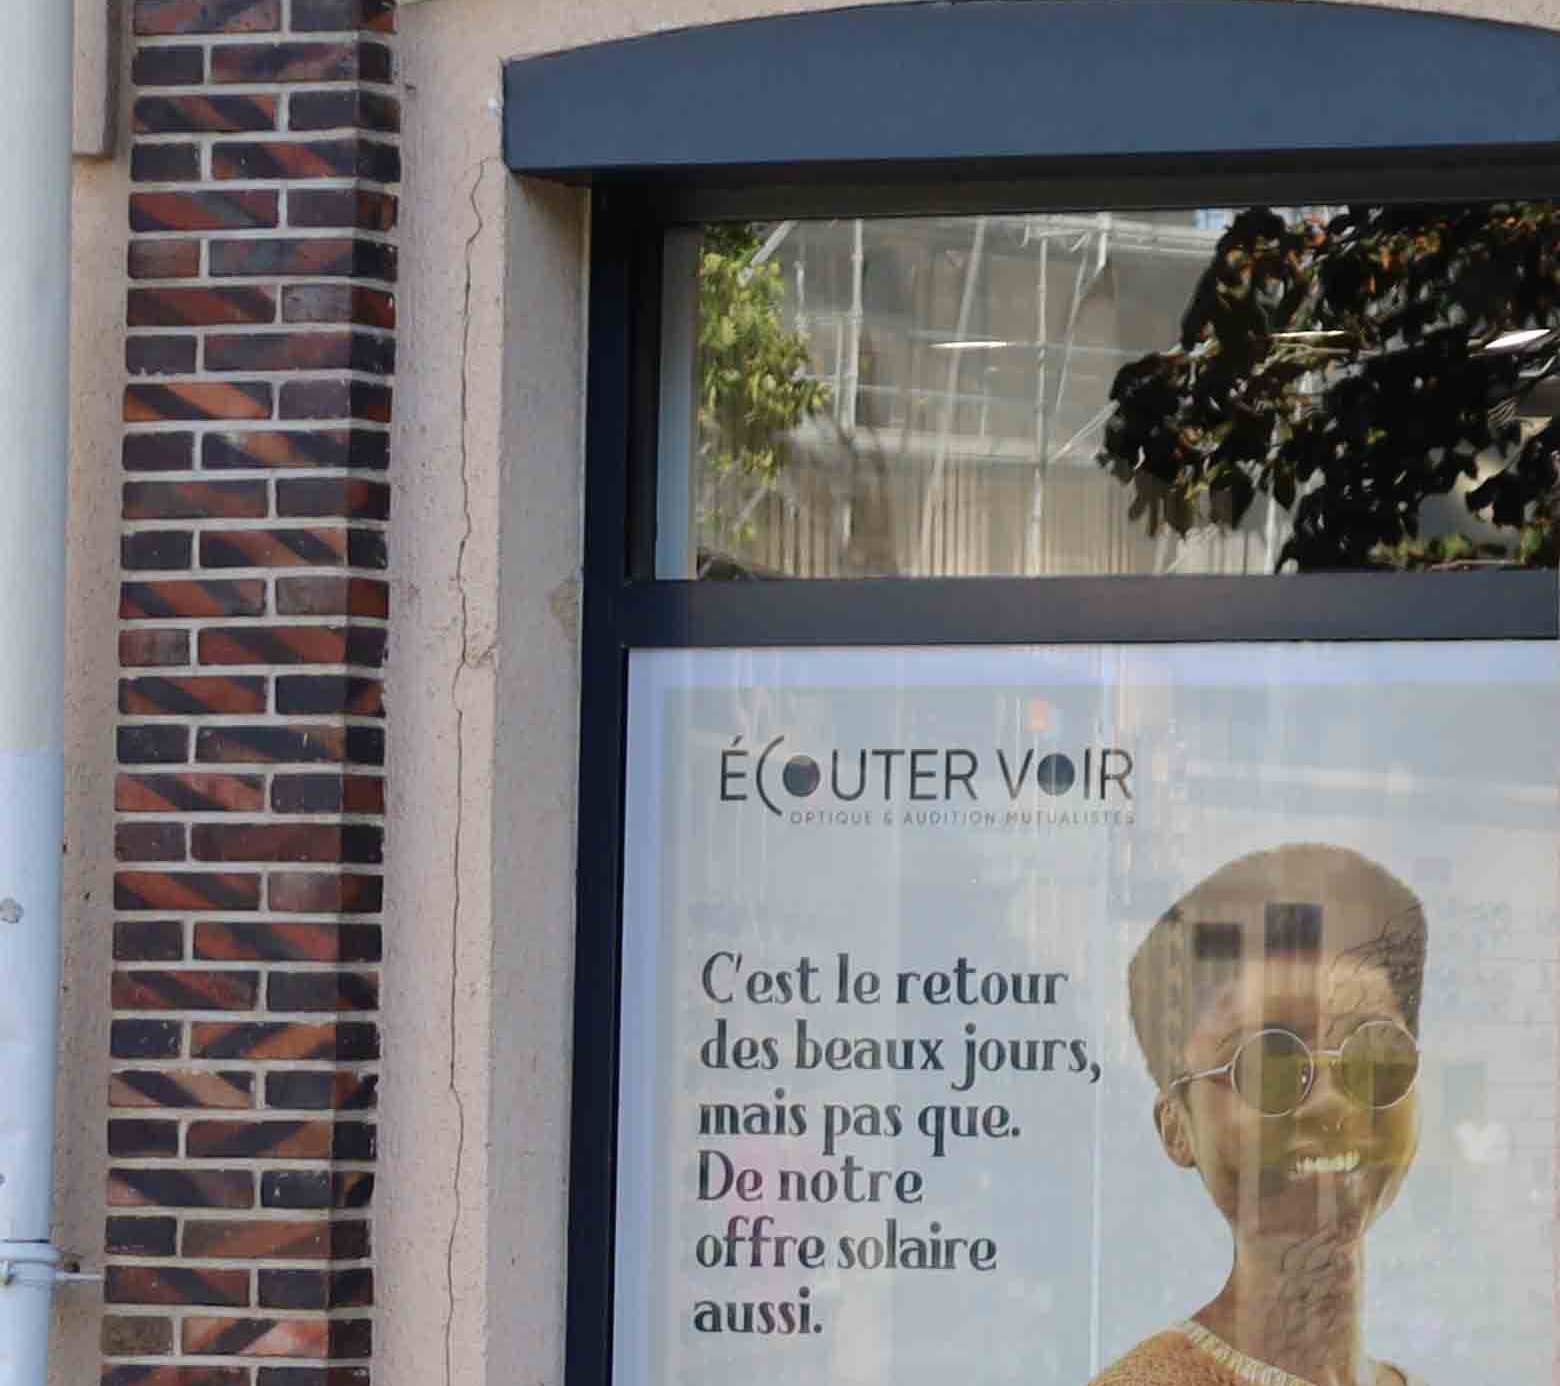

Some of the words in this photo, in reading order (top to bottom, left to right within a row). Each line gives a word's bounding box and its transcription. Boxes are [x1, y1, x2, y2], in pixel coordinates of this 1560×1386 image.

[719, 735, 979, 816] ÉCOUTER
[997, 748, 1134, 801] VOIR
[790, 811, 874, 826] OPTIQUE
[883, 812, 894, 825] &
[902, 811, 996, 826] AUDITION
[1005, 811, 1136, 826] MUTUALISTES
[701, 951, 819, 1006] C'est
[836, 953, 881, 1006] le
[895, 957, 1069, 1007] retour
[700, 1018, 779, 1070] des
[795, 1018, 945, 1071] beaux
[951, 1022, 1102, 1090] jours,
[698, 1087, 808, 1137] mais
[822, 1101, 903, 1156] pas
[917, 1101, 1021, 1158] que.
[696, 1149, 764, 1204] De
[777, 1155, 924, 1205] notre
[695, 1214, 826, 1269] offre
[837, 1218, 998, 1271] solaire
[693, 1286, 823, 1334] aussi.
